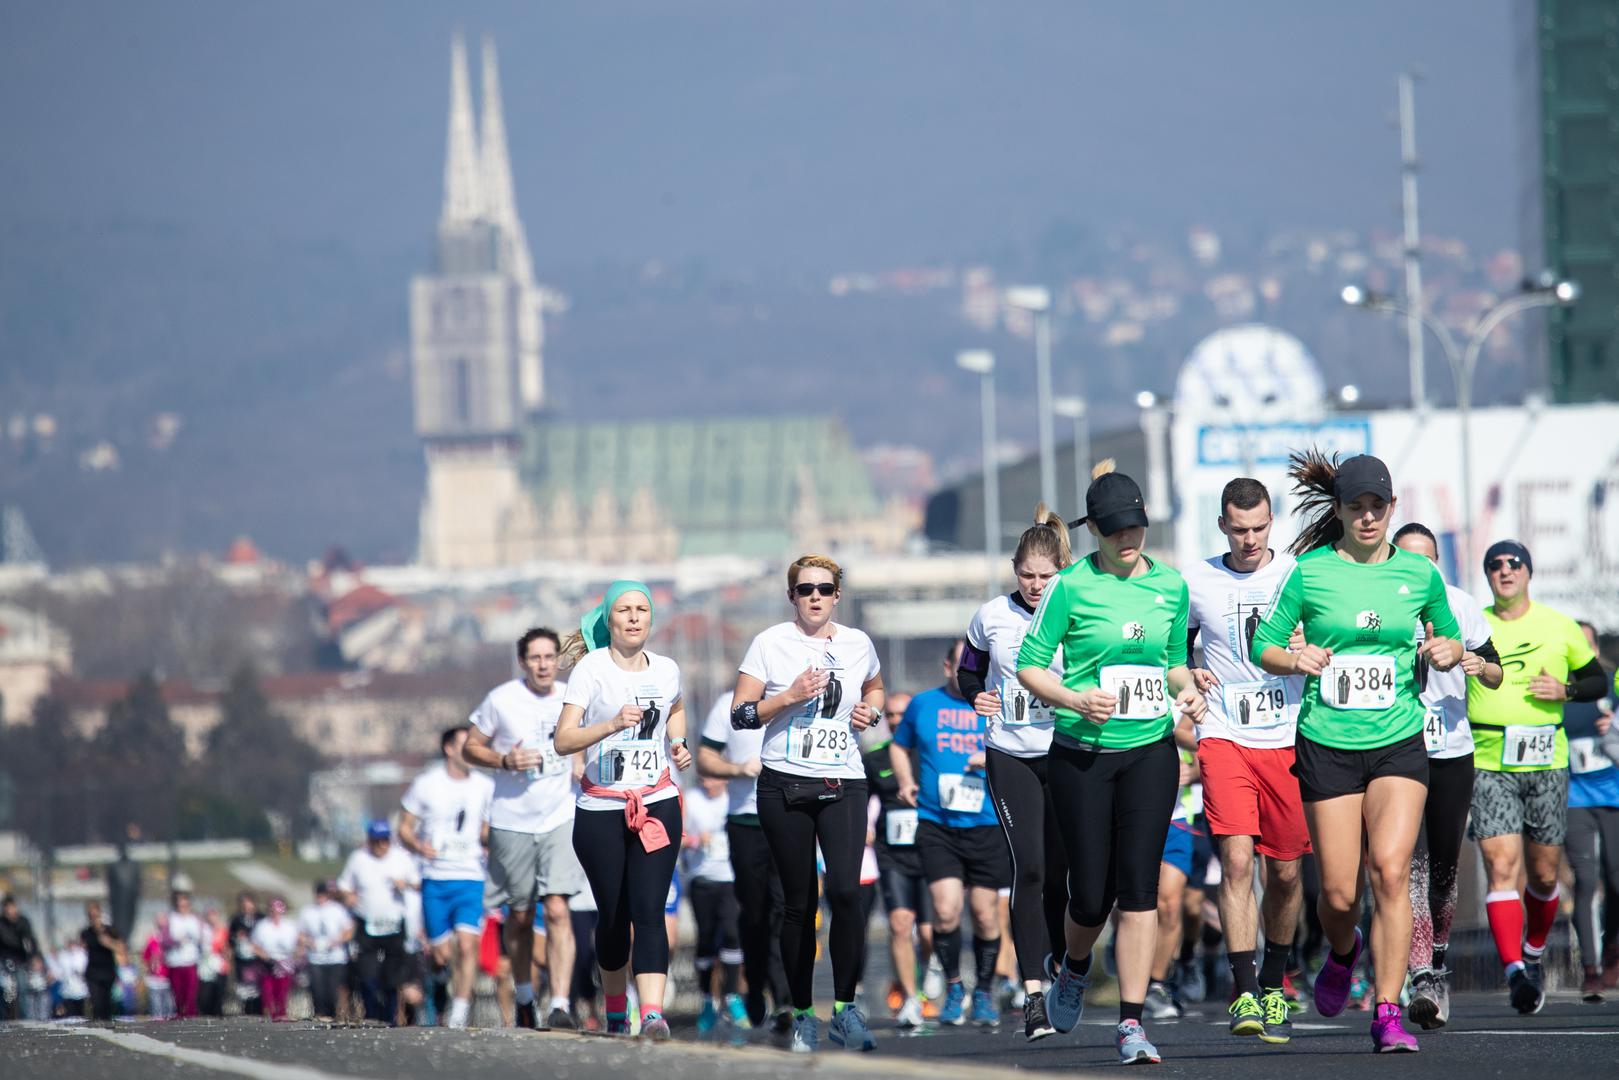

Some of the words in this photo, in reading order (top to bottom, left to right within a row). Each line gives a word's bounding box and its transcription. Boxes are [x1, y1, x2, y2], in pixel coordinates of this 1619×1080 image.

[1355, 667, 1393, 690] 384
[1134, 679, 1164, 701] 493
[1255, 689, 1285, 712] 219
[937, 709, 978, 730] RUN
[816, 729, 848, 750] 283
[1528, 734, 1553, 752] 454
[631, 750, 658, 770] 421
